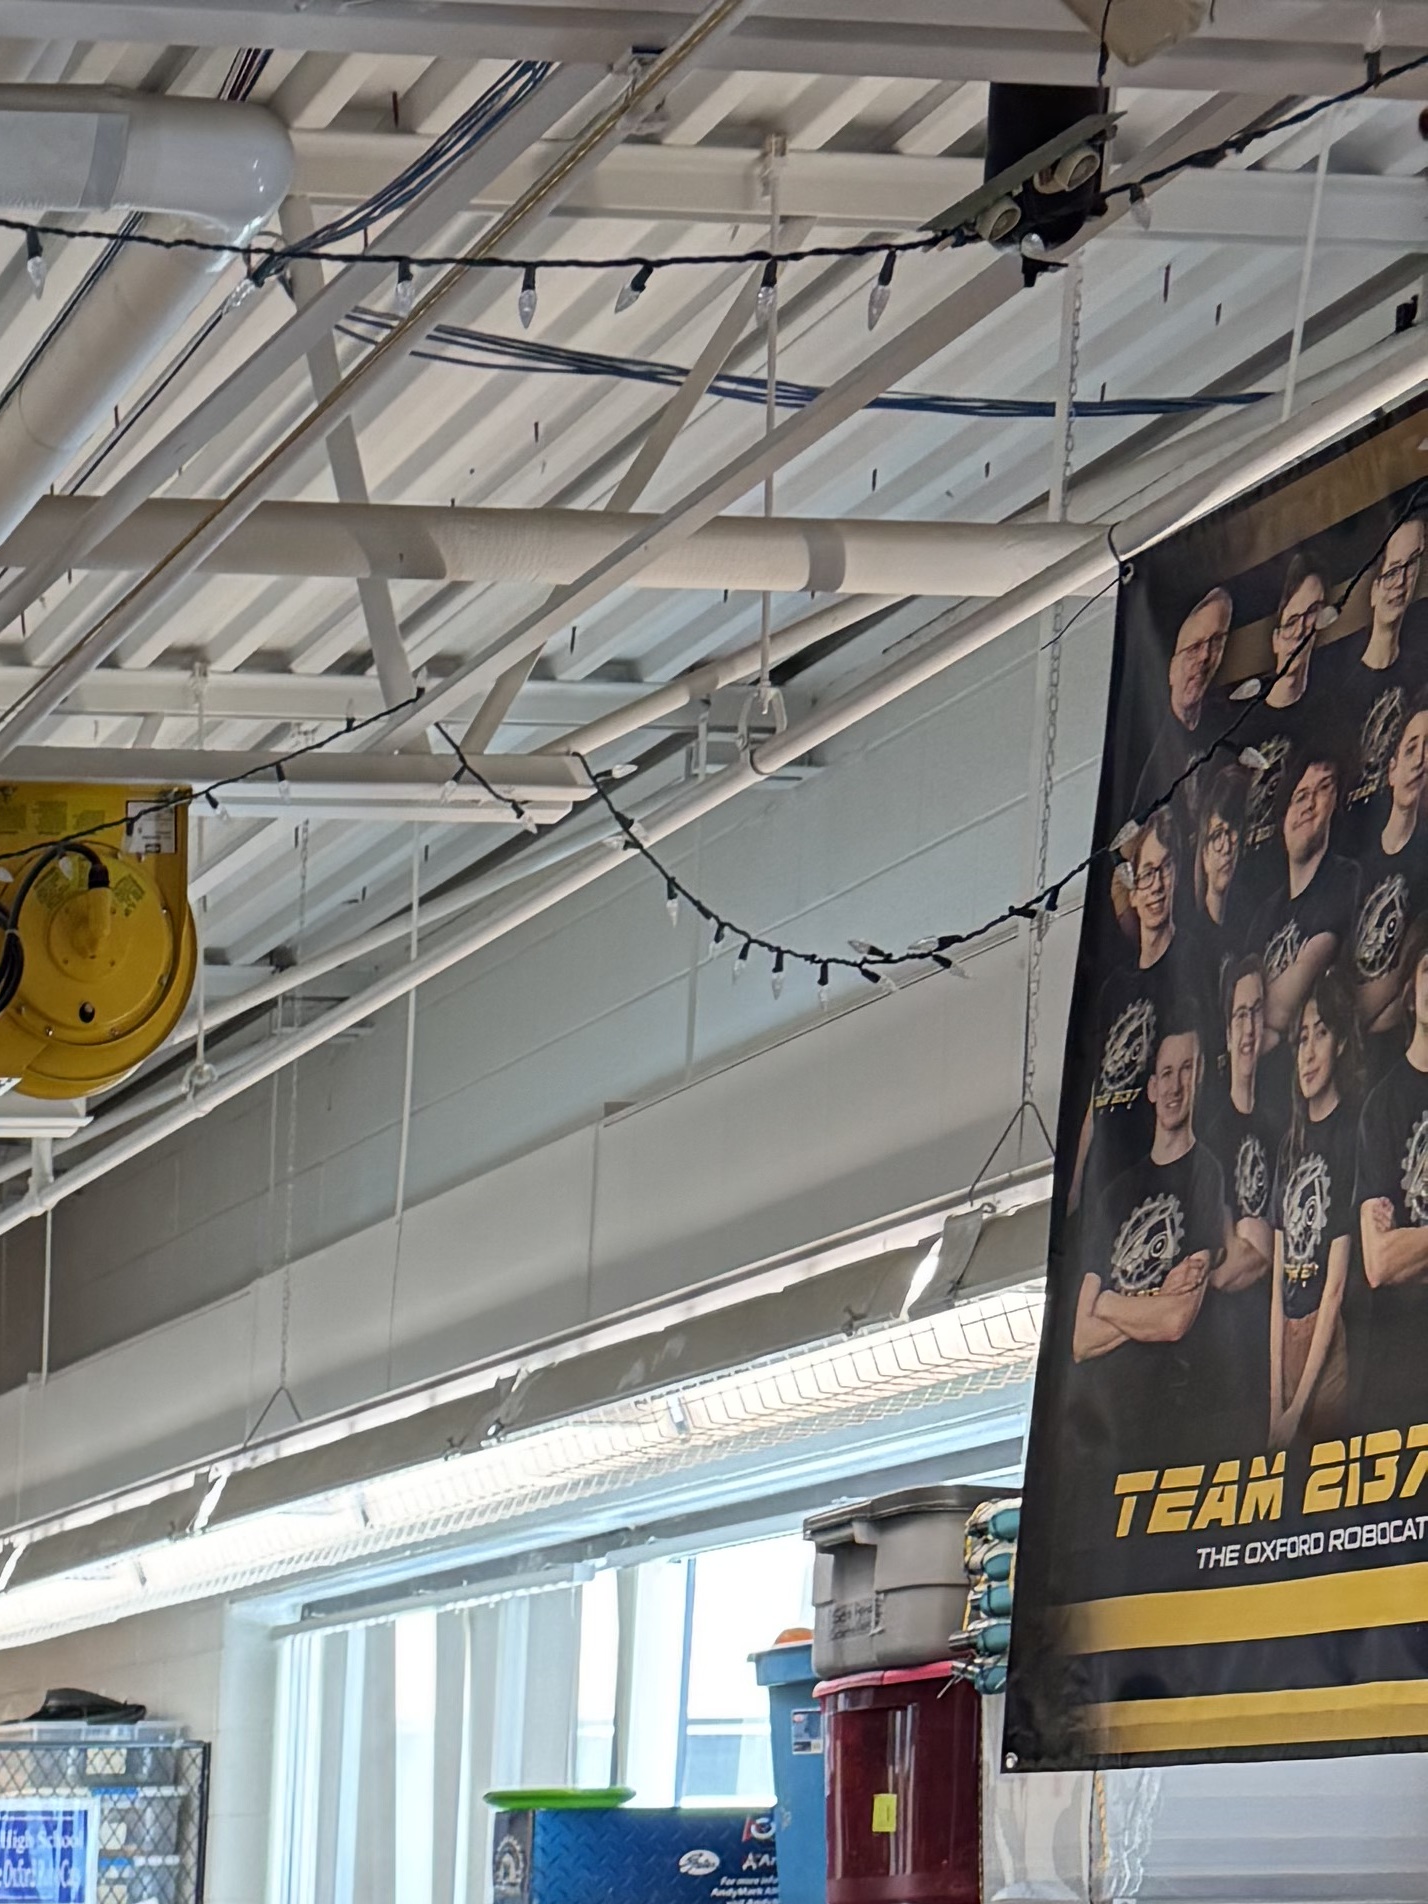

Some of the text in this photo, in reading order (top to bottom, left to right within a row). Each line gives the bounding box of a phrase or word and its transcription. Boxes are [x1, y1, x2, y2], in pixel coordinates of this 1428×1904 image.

[1114, 1424, 1428, 1538] TEAM 2137
[1197, 1545, 1240, 1570] THE
[1244, 1532, 1324, 1565] OXFORD
